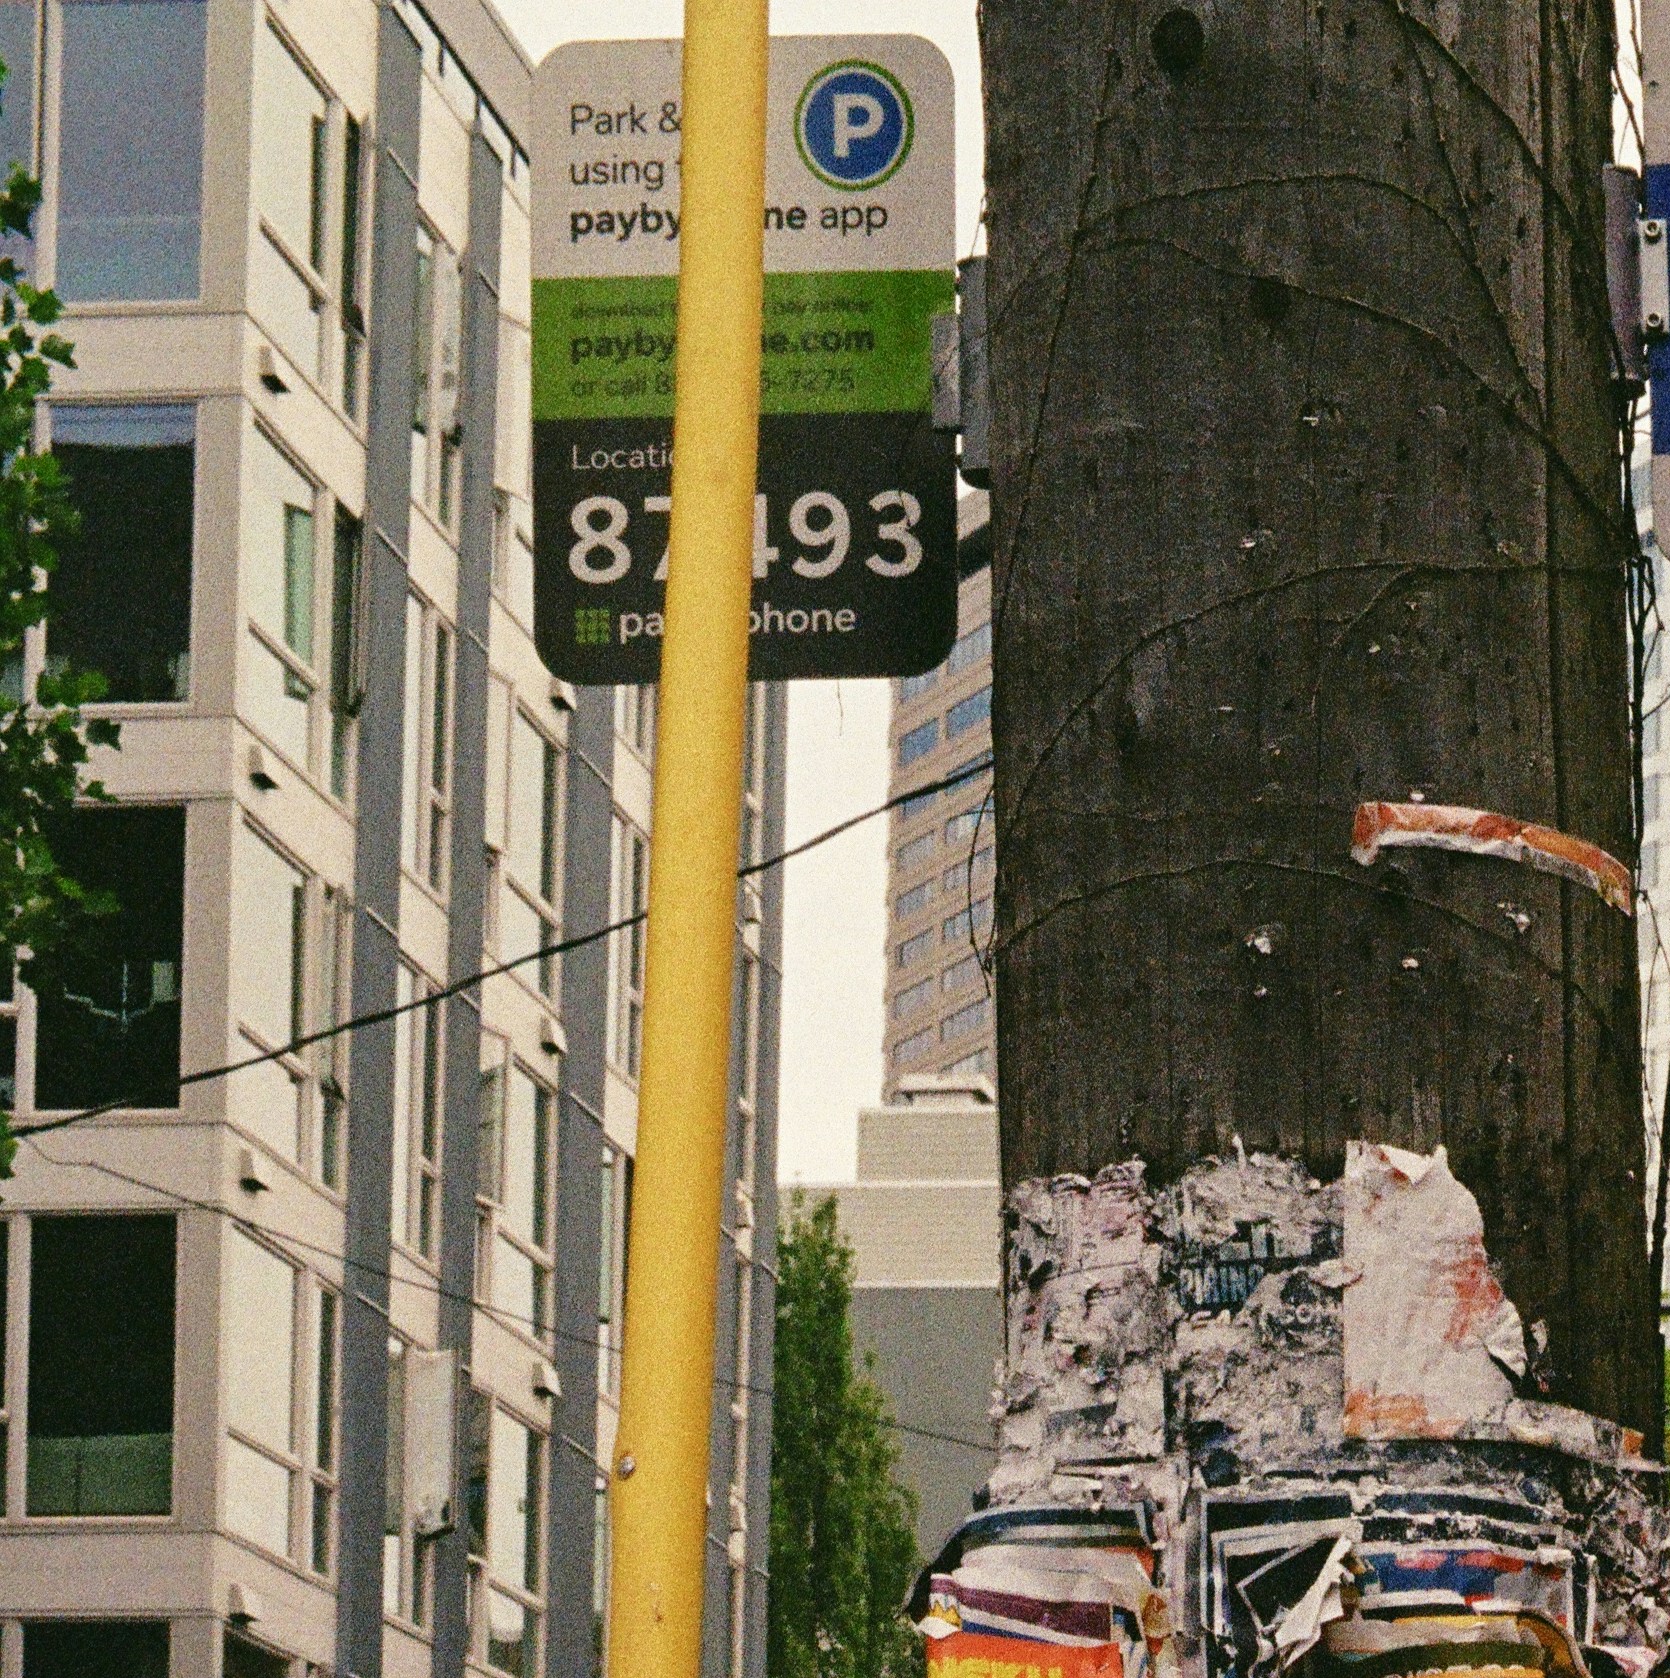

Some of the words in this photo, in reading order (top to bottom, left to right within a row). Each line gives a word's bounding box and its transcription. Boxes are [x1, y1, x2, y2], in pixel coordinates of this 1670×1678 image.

[570, 102, 647, 136] Park
[570, 156, 665, 192] using
[570, 203, 806, 243] paybyne
[819, 204, 888, 236] app
